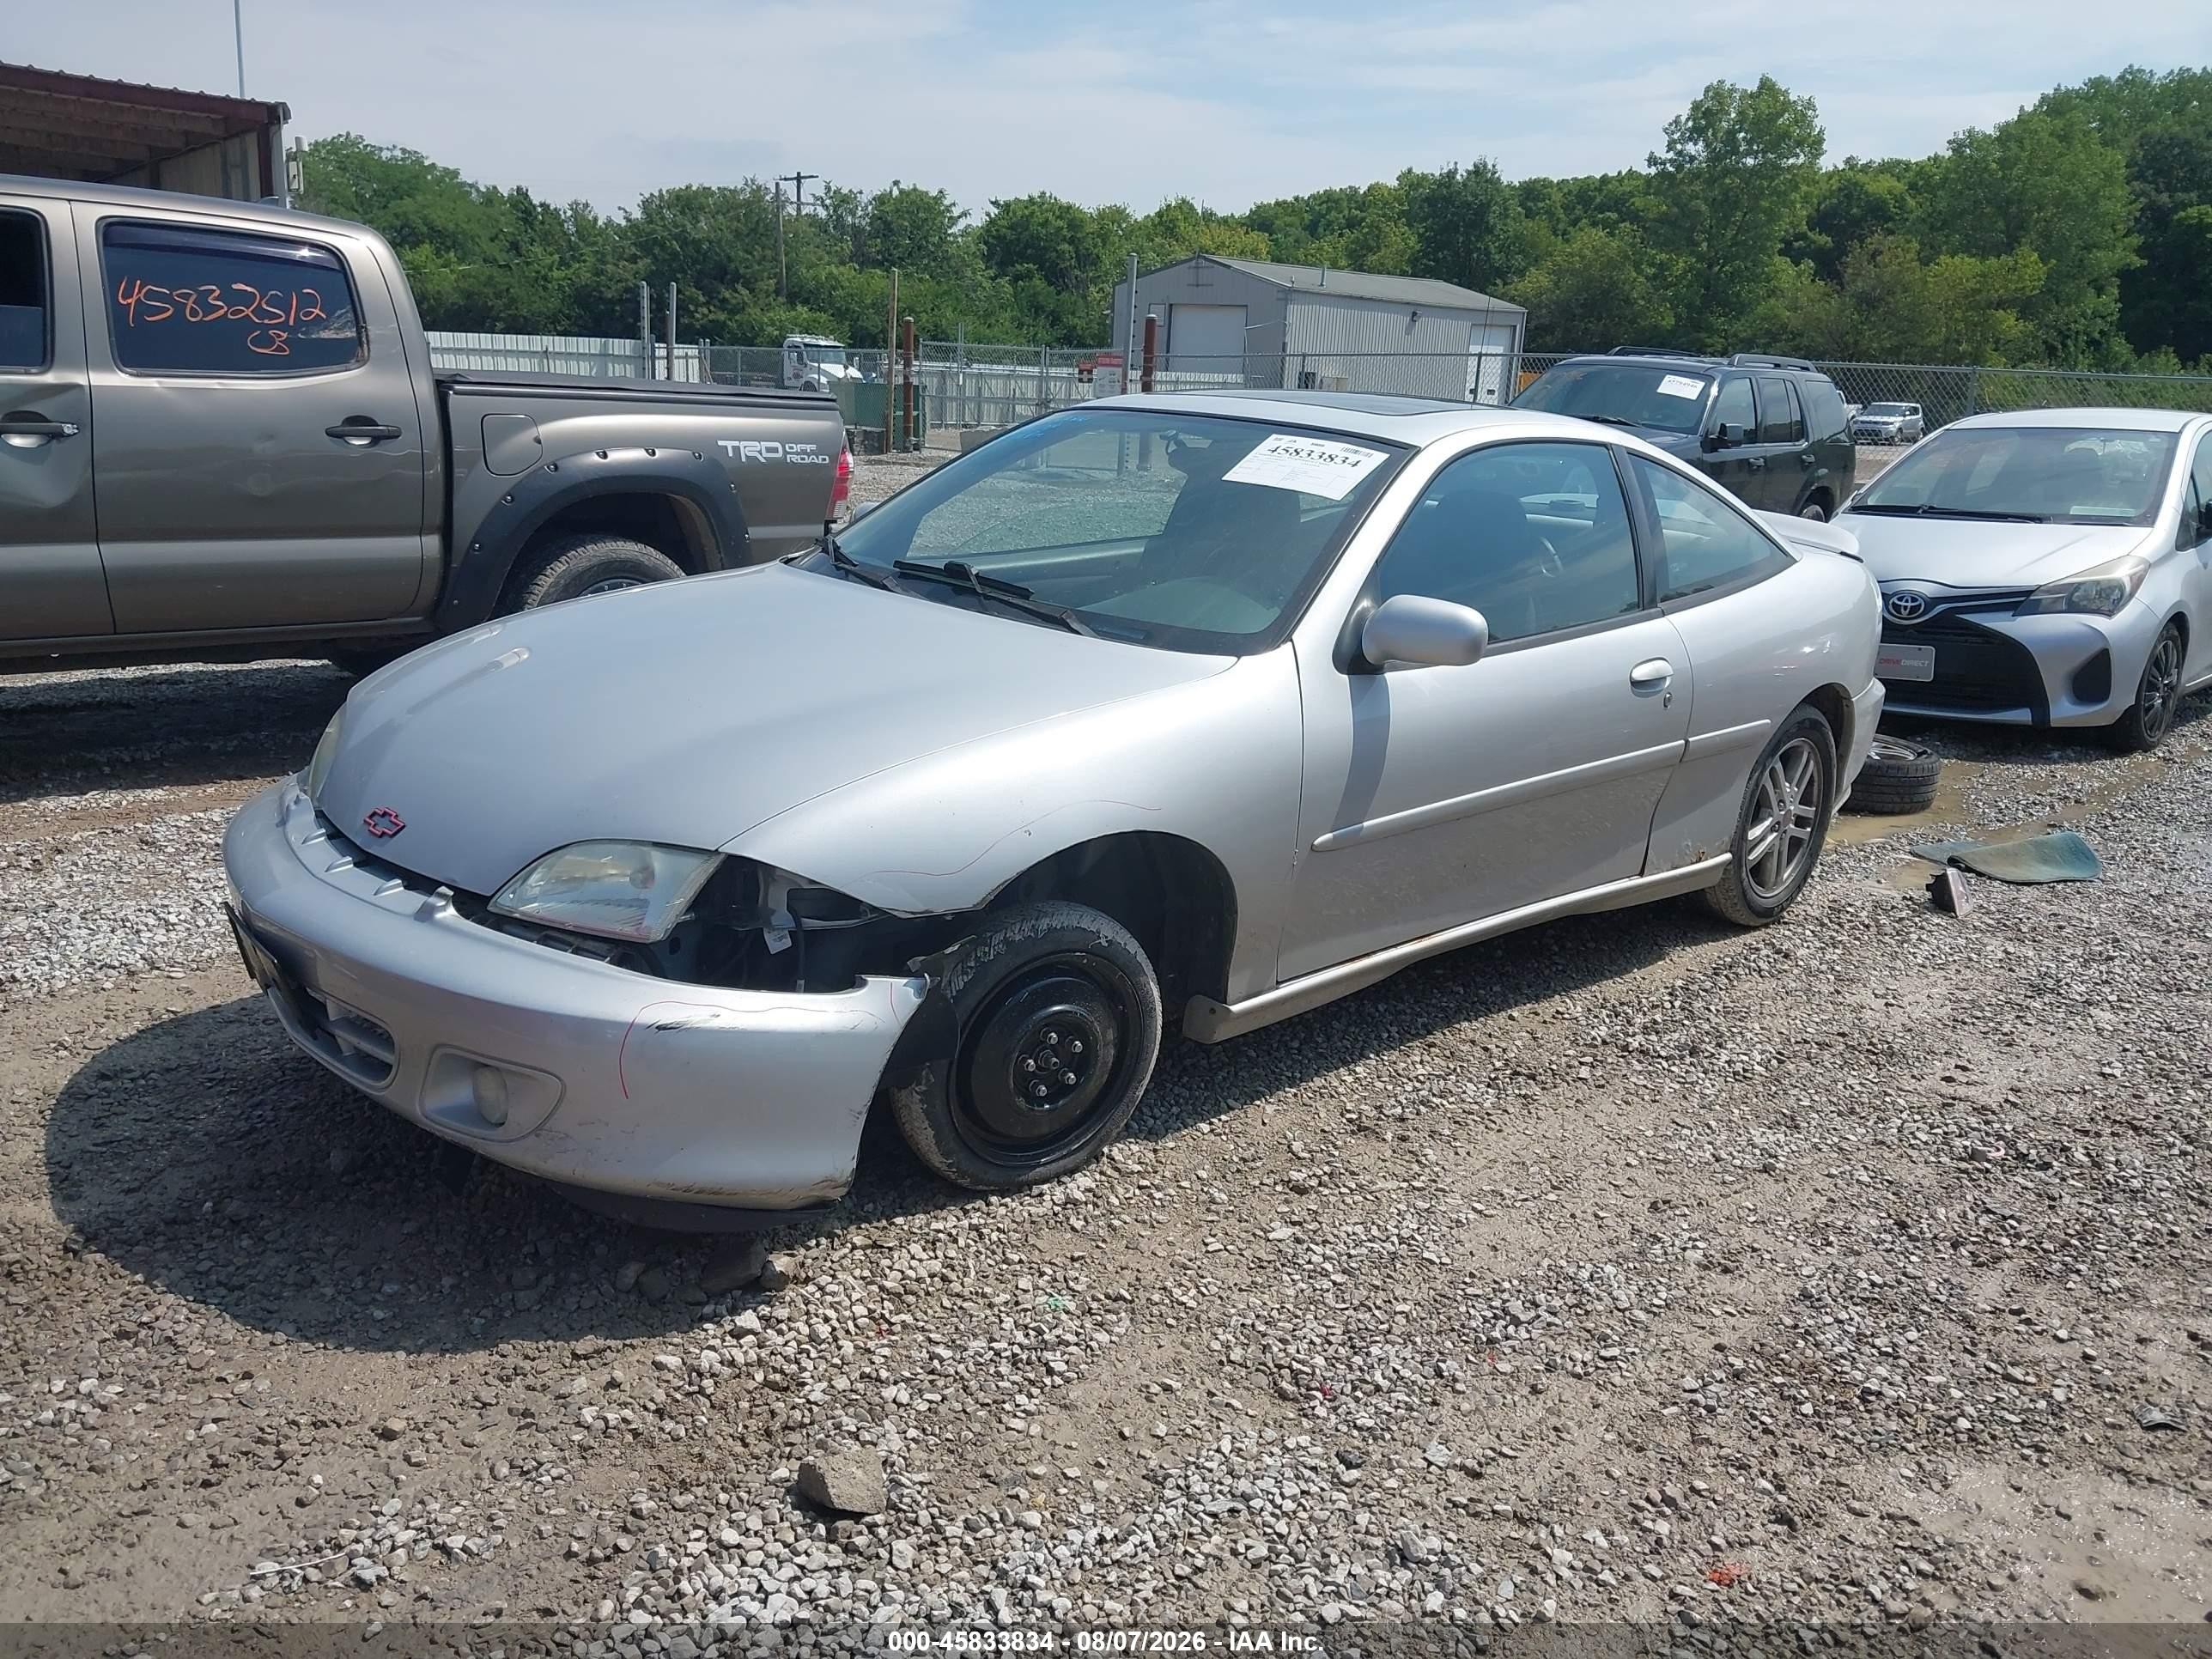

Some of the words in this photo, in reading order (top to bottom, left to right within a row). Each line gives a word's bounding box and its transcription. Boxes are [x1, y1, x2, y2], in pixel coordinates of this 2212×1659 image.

[117, 276, 327, 327] 45832512
[716, 440, 784, 464] TRD
[785, 443, 817, 453] OFF
[786, 454, 830, 465] ROAD
[1267, 444, 1363, 468] 45833834
